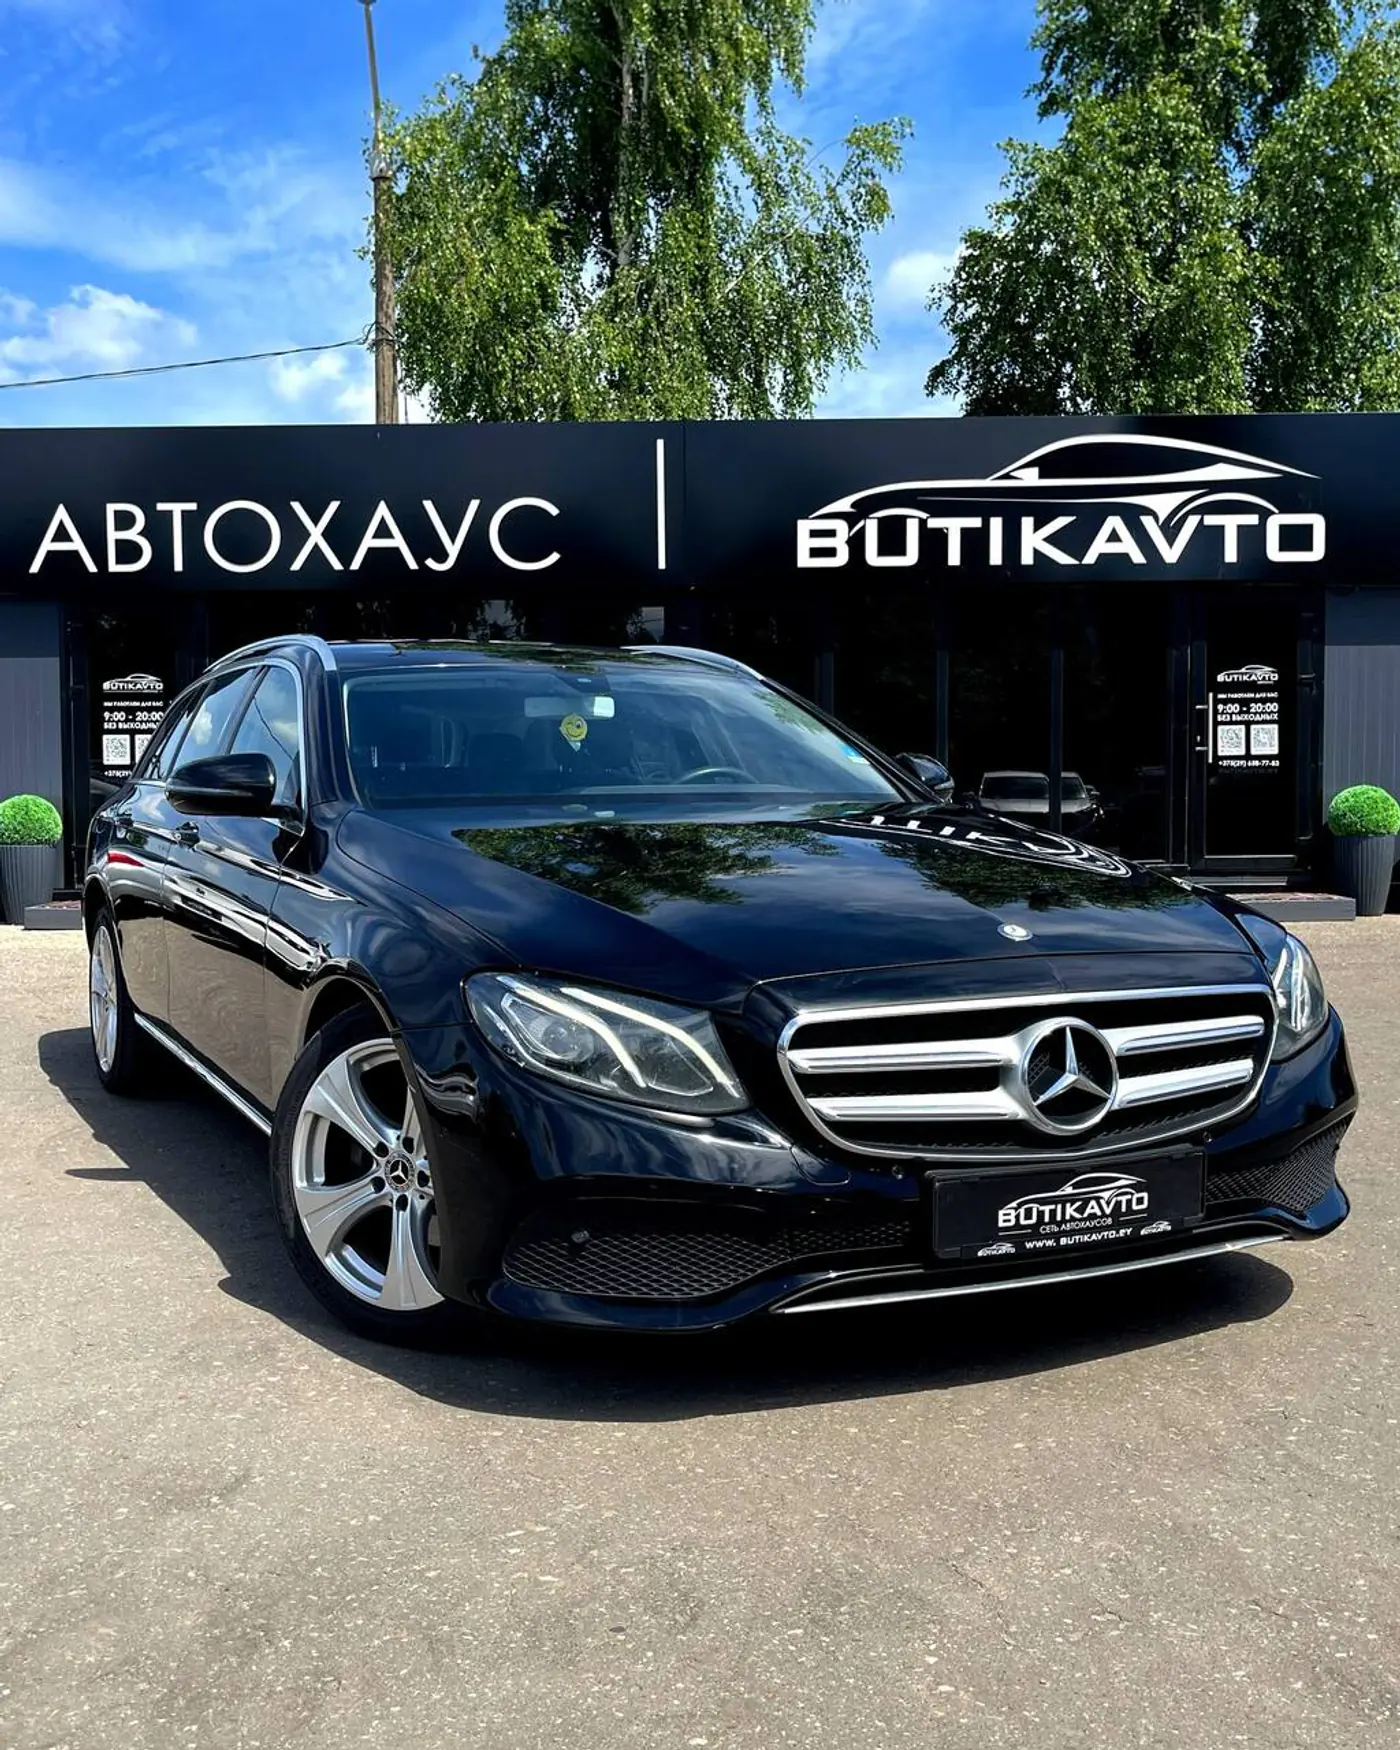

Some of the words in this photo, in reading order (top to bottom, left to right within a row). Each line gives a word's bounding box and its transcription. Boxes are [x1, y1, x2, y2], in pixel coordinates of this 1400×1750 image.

[28, 497, 562, 575] АВТОХАУС
[796, 512, 1326, 568] BUTIKAVTO
[1217, 673, 1279, 682] BUTIKAVTO
[102, 681, 164, 690] BUTIKAVTO
[1217, 703, 1240, 713] 9:00
[1249, 702, 1279, 712] 20:00
[103, 711, 126, 721] 9:00
[1232, 713, 1279, 721] ВЫХОДНЫХ
[997, 1191, 1149, 1228] BUTIKAVTO
[1039, 1224, 1060, 1235] СЕТЬ
[1060, 1217, 1113, 1231] АВТОХАУСОВ
[1024, 1239, 1057, 1250] WWW.
